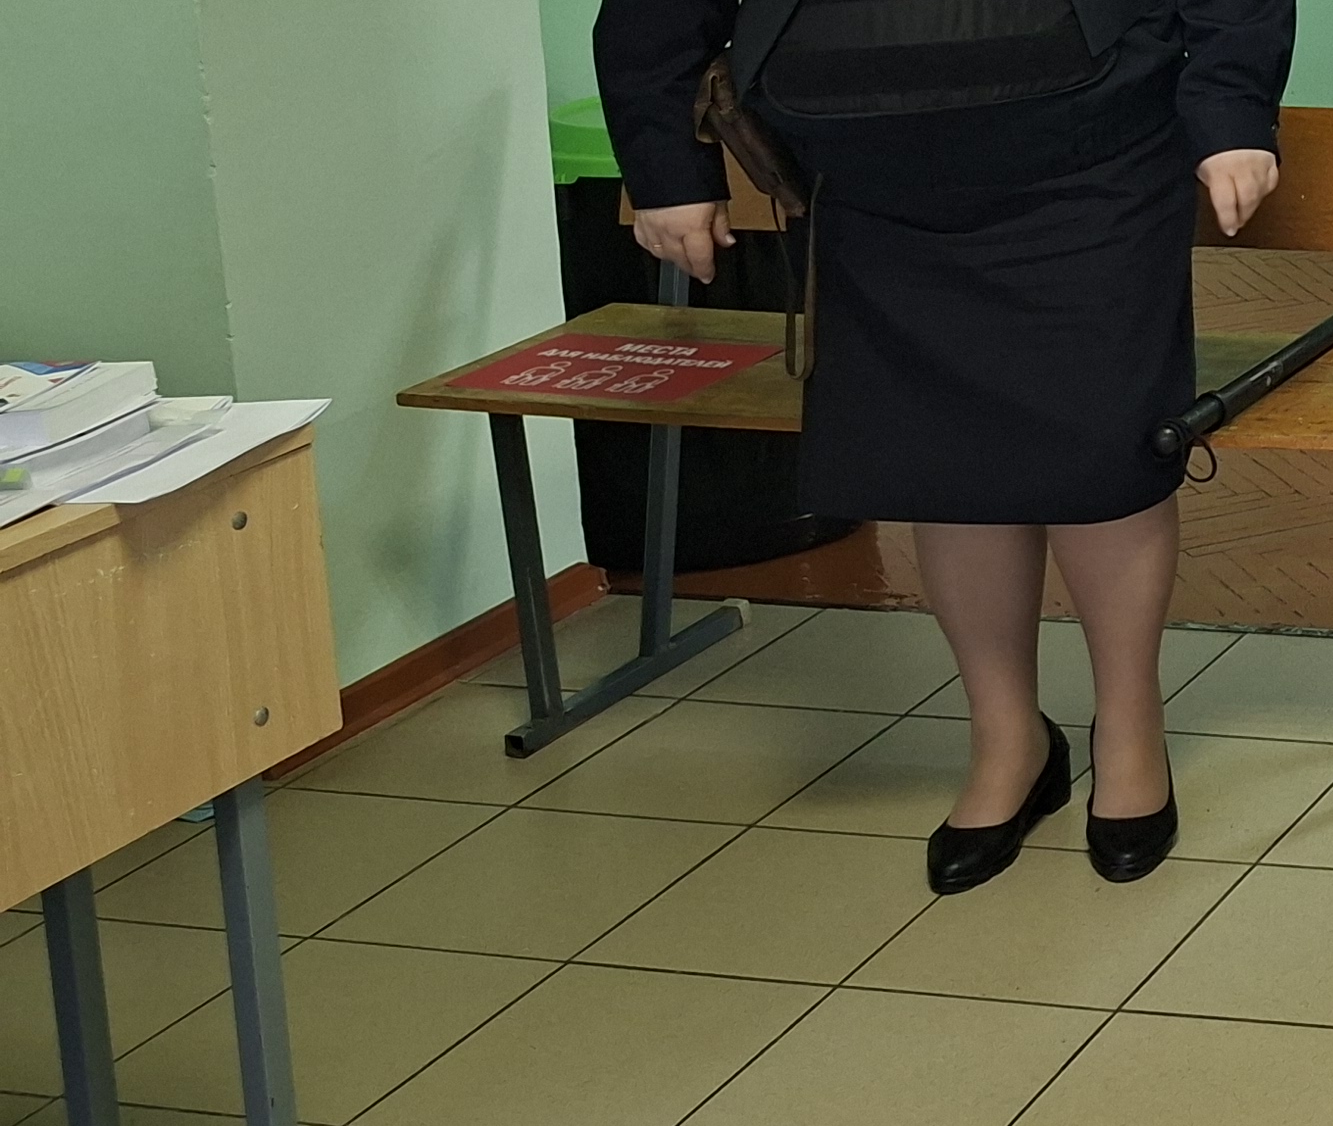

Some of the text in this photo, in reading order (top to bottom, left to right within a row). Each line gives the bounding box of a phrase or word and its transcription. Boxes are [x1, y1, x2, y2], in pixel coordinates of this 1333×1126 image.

[615, 343, 698, 356] МЕСТА
[538, 349, 734, 368] ДЛЯ НАБЛЮДАТЕЛЕЙ
